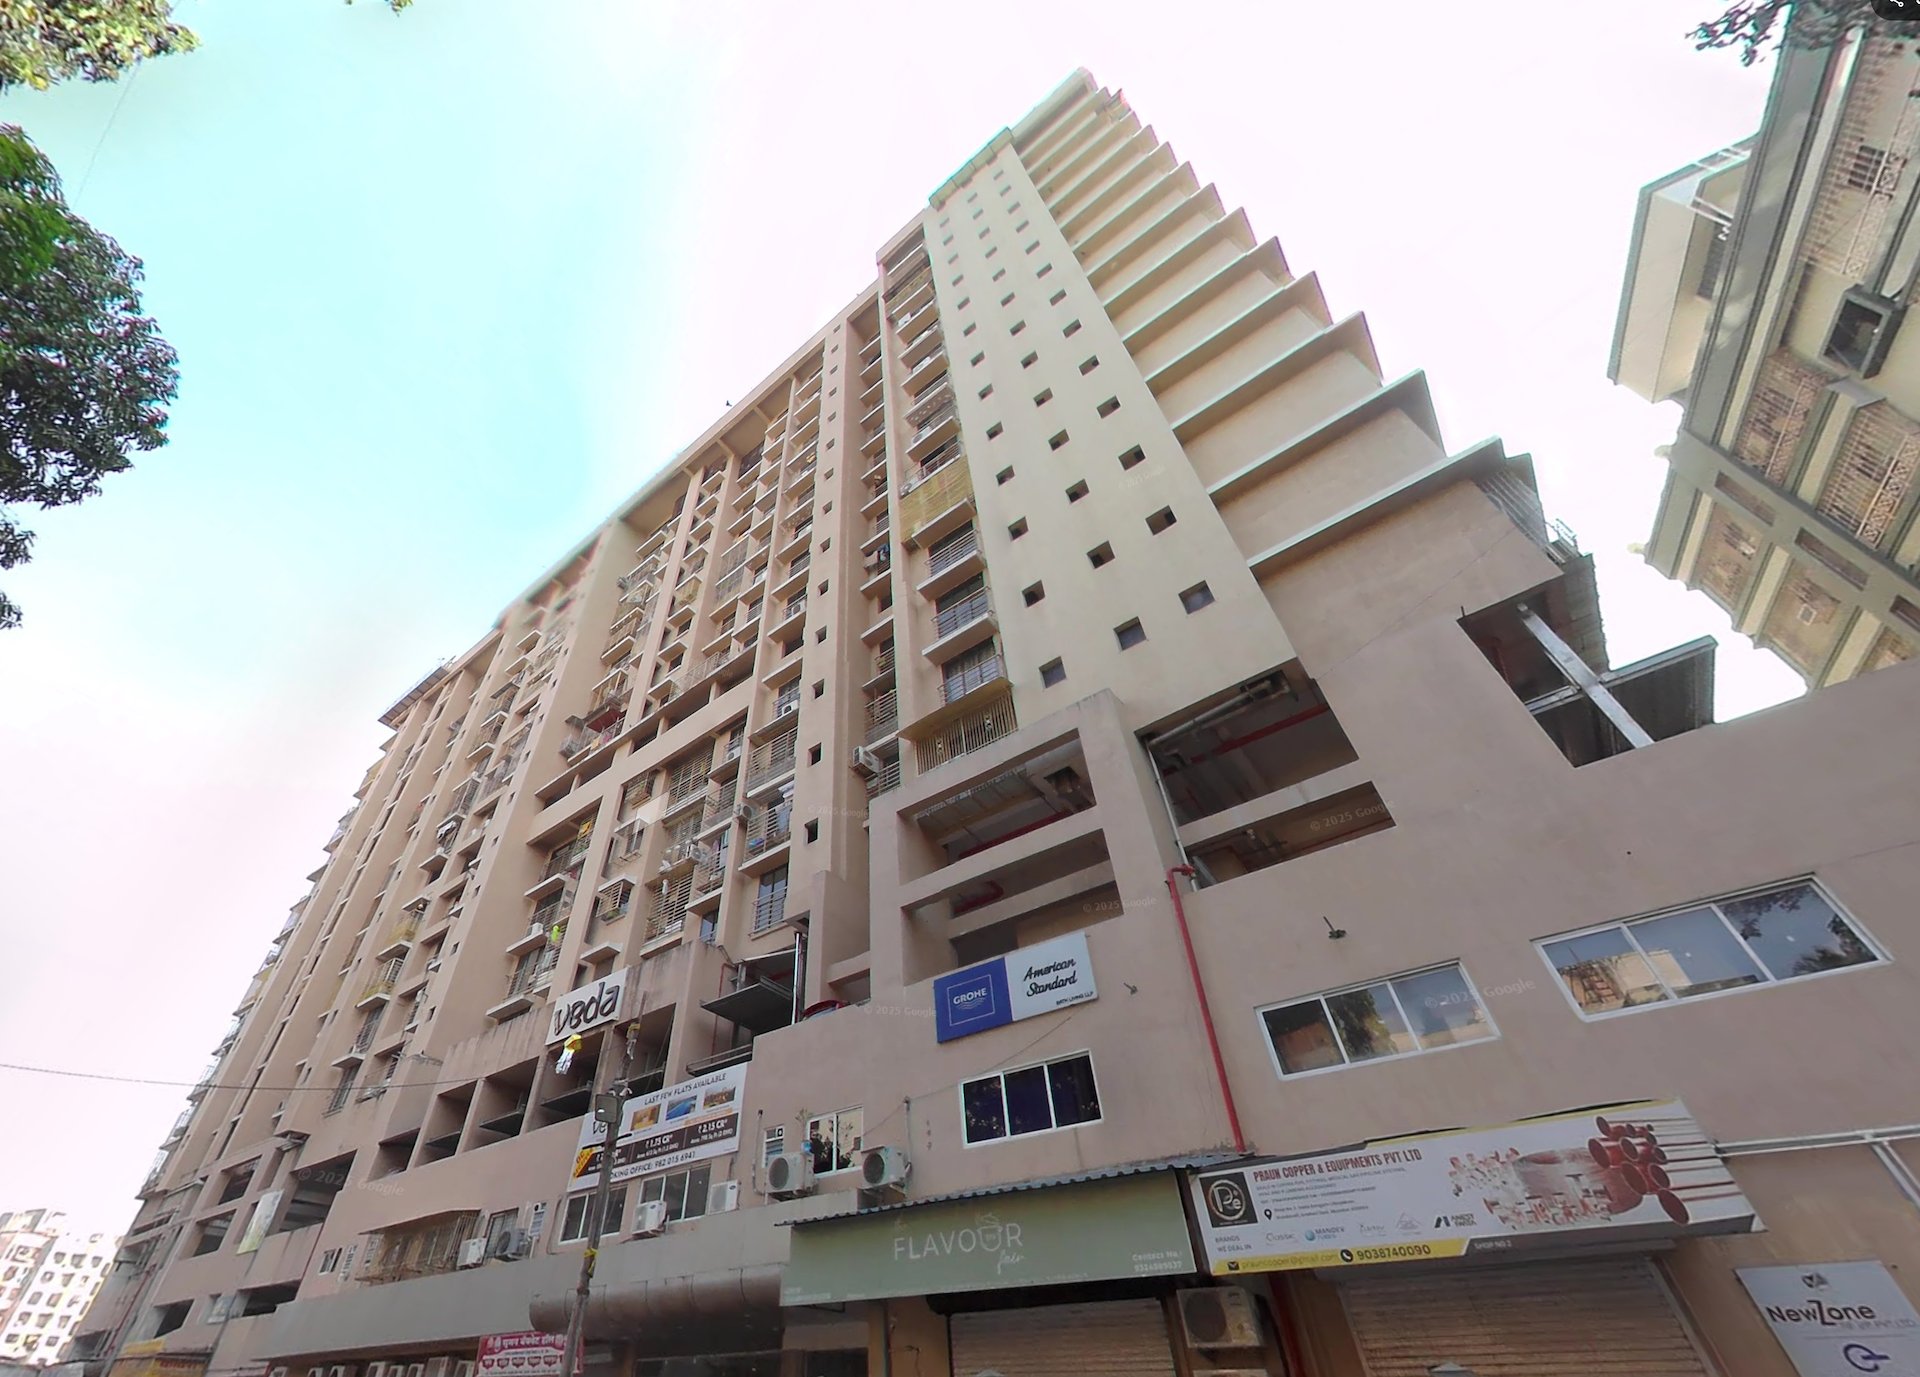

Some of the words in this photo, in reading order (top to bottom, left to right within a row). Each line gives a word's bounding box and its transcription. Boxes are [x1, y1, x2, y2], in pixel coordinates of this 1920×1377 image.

[1024, 957, 1077, 982] American
[953, 987, 988, 1005] GROHE
[1026, 970, 1077, 997] Standard
[554, 981, 620, 1036] veda
[644, 1094, 660, 1106] LAST
[660, 1090, 672, 1100] FEW
[674, 1084, 692, 1096] FLATS
[693, 1073, 727, 1090] AVAILABLE
[630, 1162, 653, 1175] OFFICE:
[654, 1158, 667, 1169] 982
[667, 1155, 680, 1166] 015
[1253, 1168, 1281, 1183] PRAUN
[1282, 1164, 1316, 1178] COPPER
[1318, 1163, 1324, 1174] &
[1327, 1154, 1382, 1172] EQUIPMENTS
[1384, 1151, 1401, 1165] PVT
[1403, 1148, 1422, 1162] LTD
[894, 1223, 1023, 1260] FLAVOUR
[1215, 1235, 1240, 1244] BRANDS
[1356, 1244, 1431, 1260] 9038740090
[1132, 1252, 1164, 1262] Contact
[1765, 1300, 1876, 1326] NewZone
